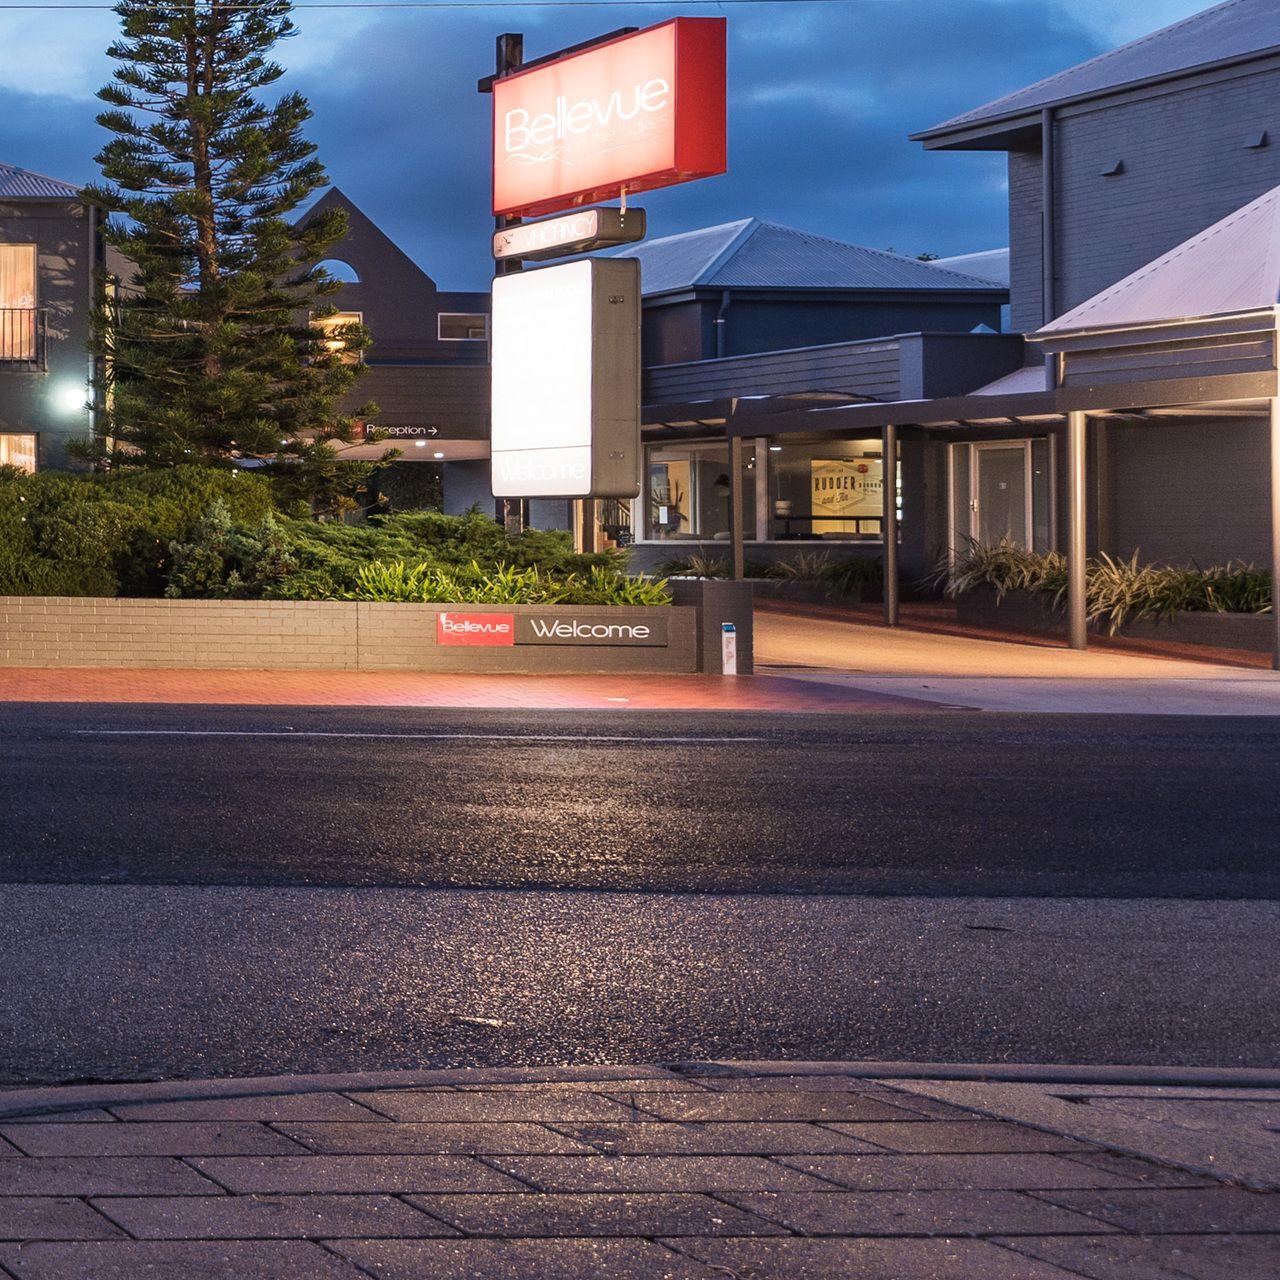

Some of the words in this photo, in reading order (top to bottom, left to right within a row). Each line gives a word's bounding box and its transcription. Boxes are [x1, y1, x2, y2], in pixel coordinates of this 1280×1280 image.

[505, 78, 669, 152] Bellevue
[524, 214, 595, 247] VACANCY
[497, 456, 586, 481] Welcome
[815, 476, 855, 491] RUDDER
[443, 619, 510, 633] Bellevue
[530, 619, 650, 639] Welcome
